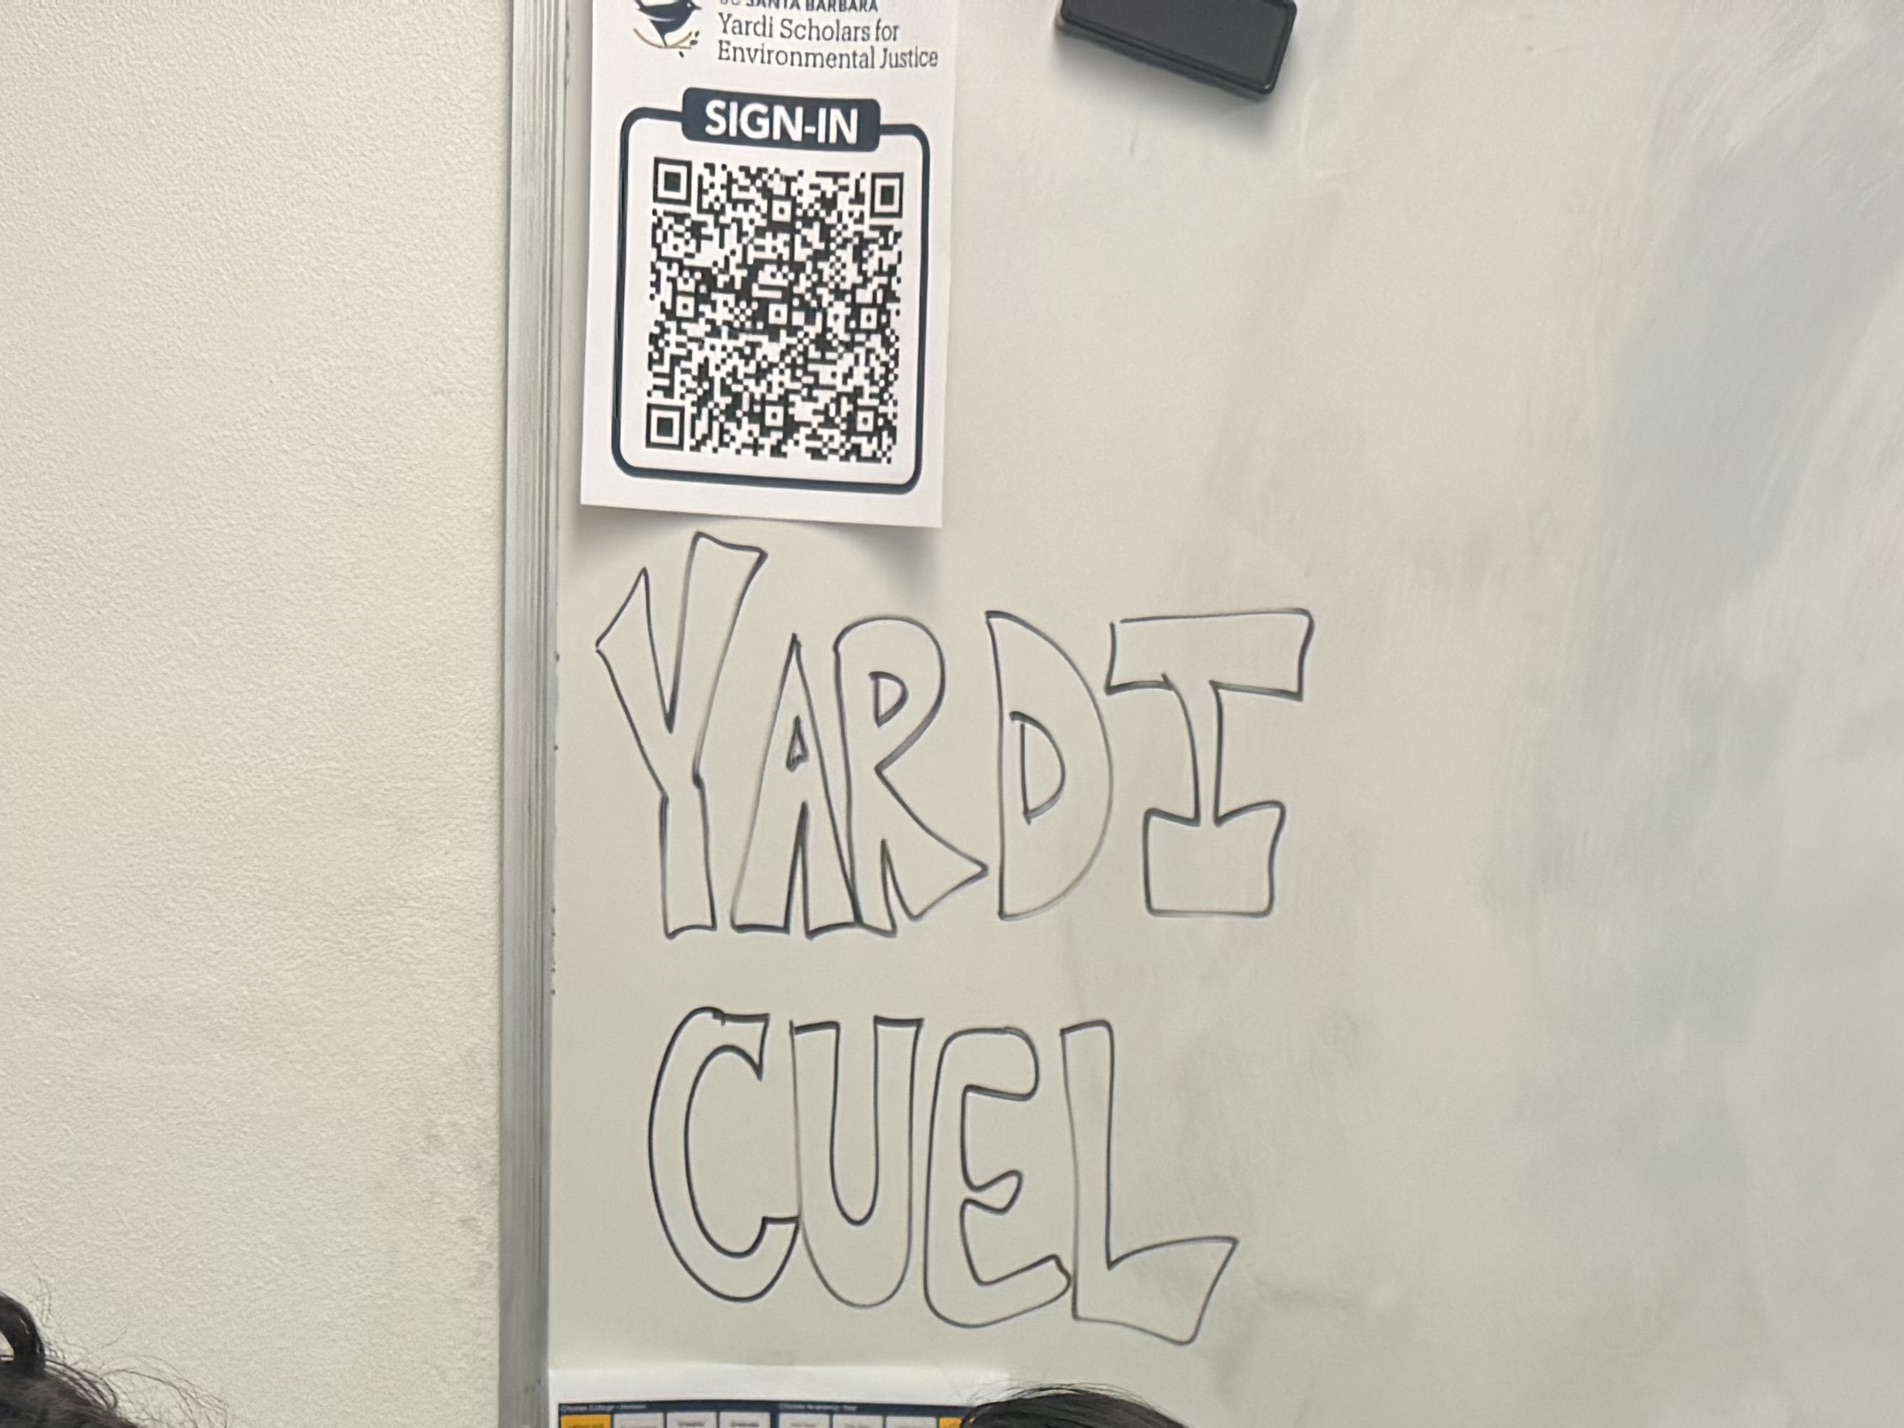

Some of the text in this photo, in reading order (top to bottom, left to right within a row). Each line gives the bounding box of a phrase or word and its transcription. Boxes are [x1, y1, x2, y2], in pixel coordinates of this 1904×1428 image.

[805, 0, 878, 12] BARBARA
[717, 11, 900, 42] Yardi Scholars for
[717, 39, 939, 69] Environmental Justice
[704, 99, 859, 145] SIGN-IN
[595, 530, 1314, 939] YARDI
[647, 1005, 1240, 1346] CUEL
